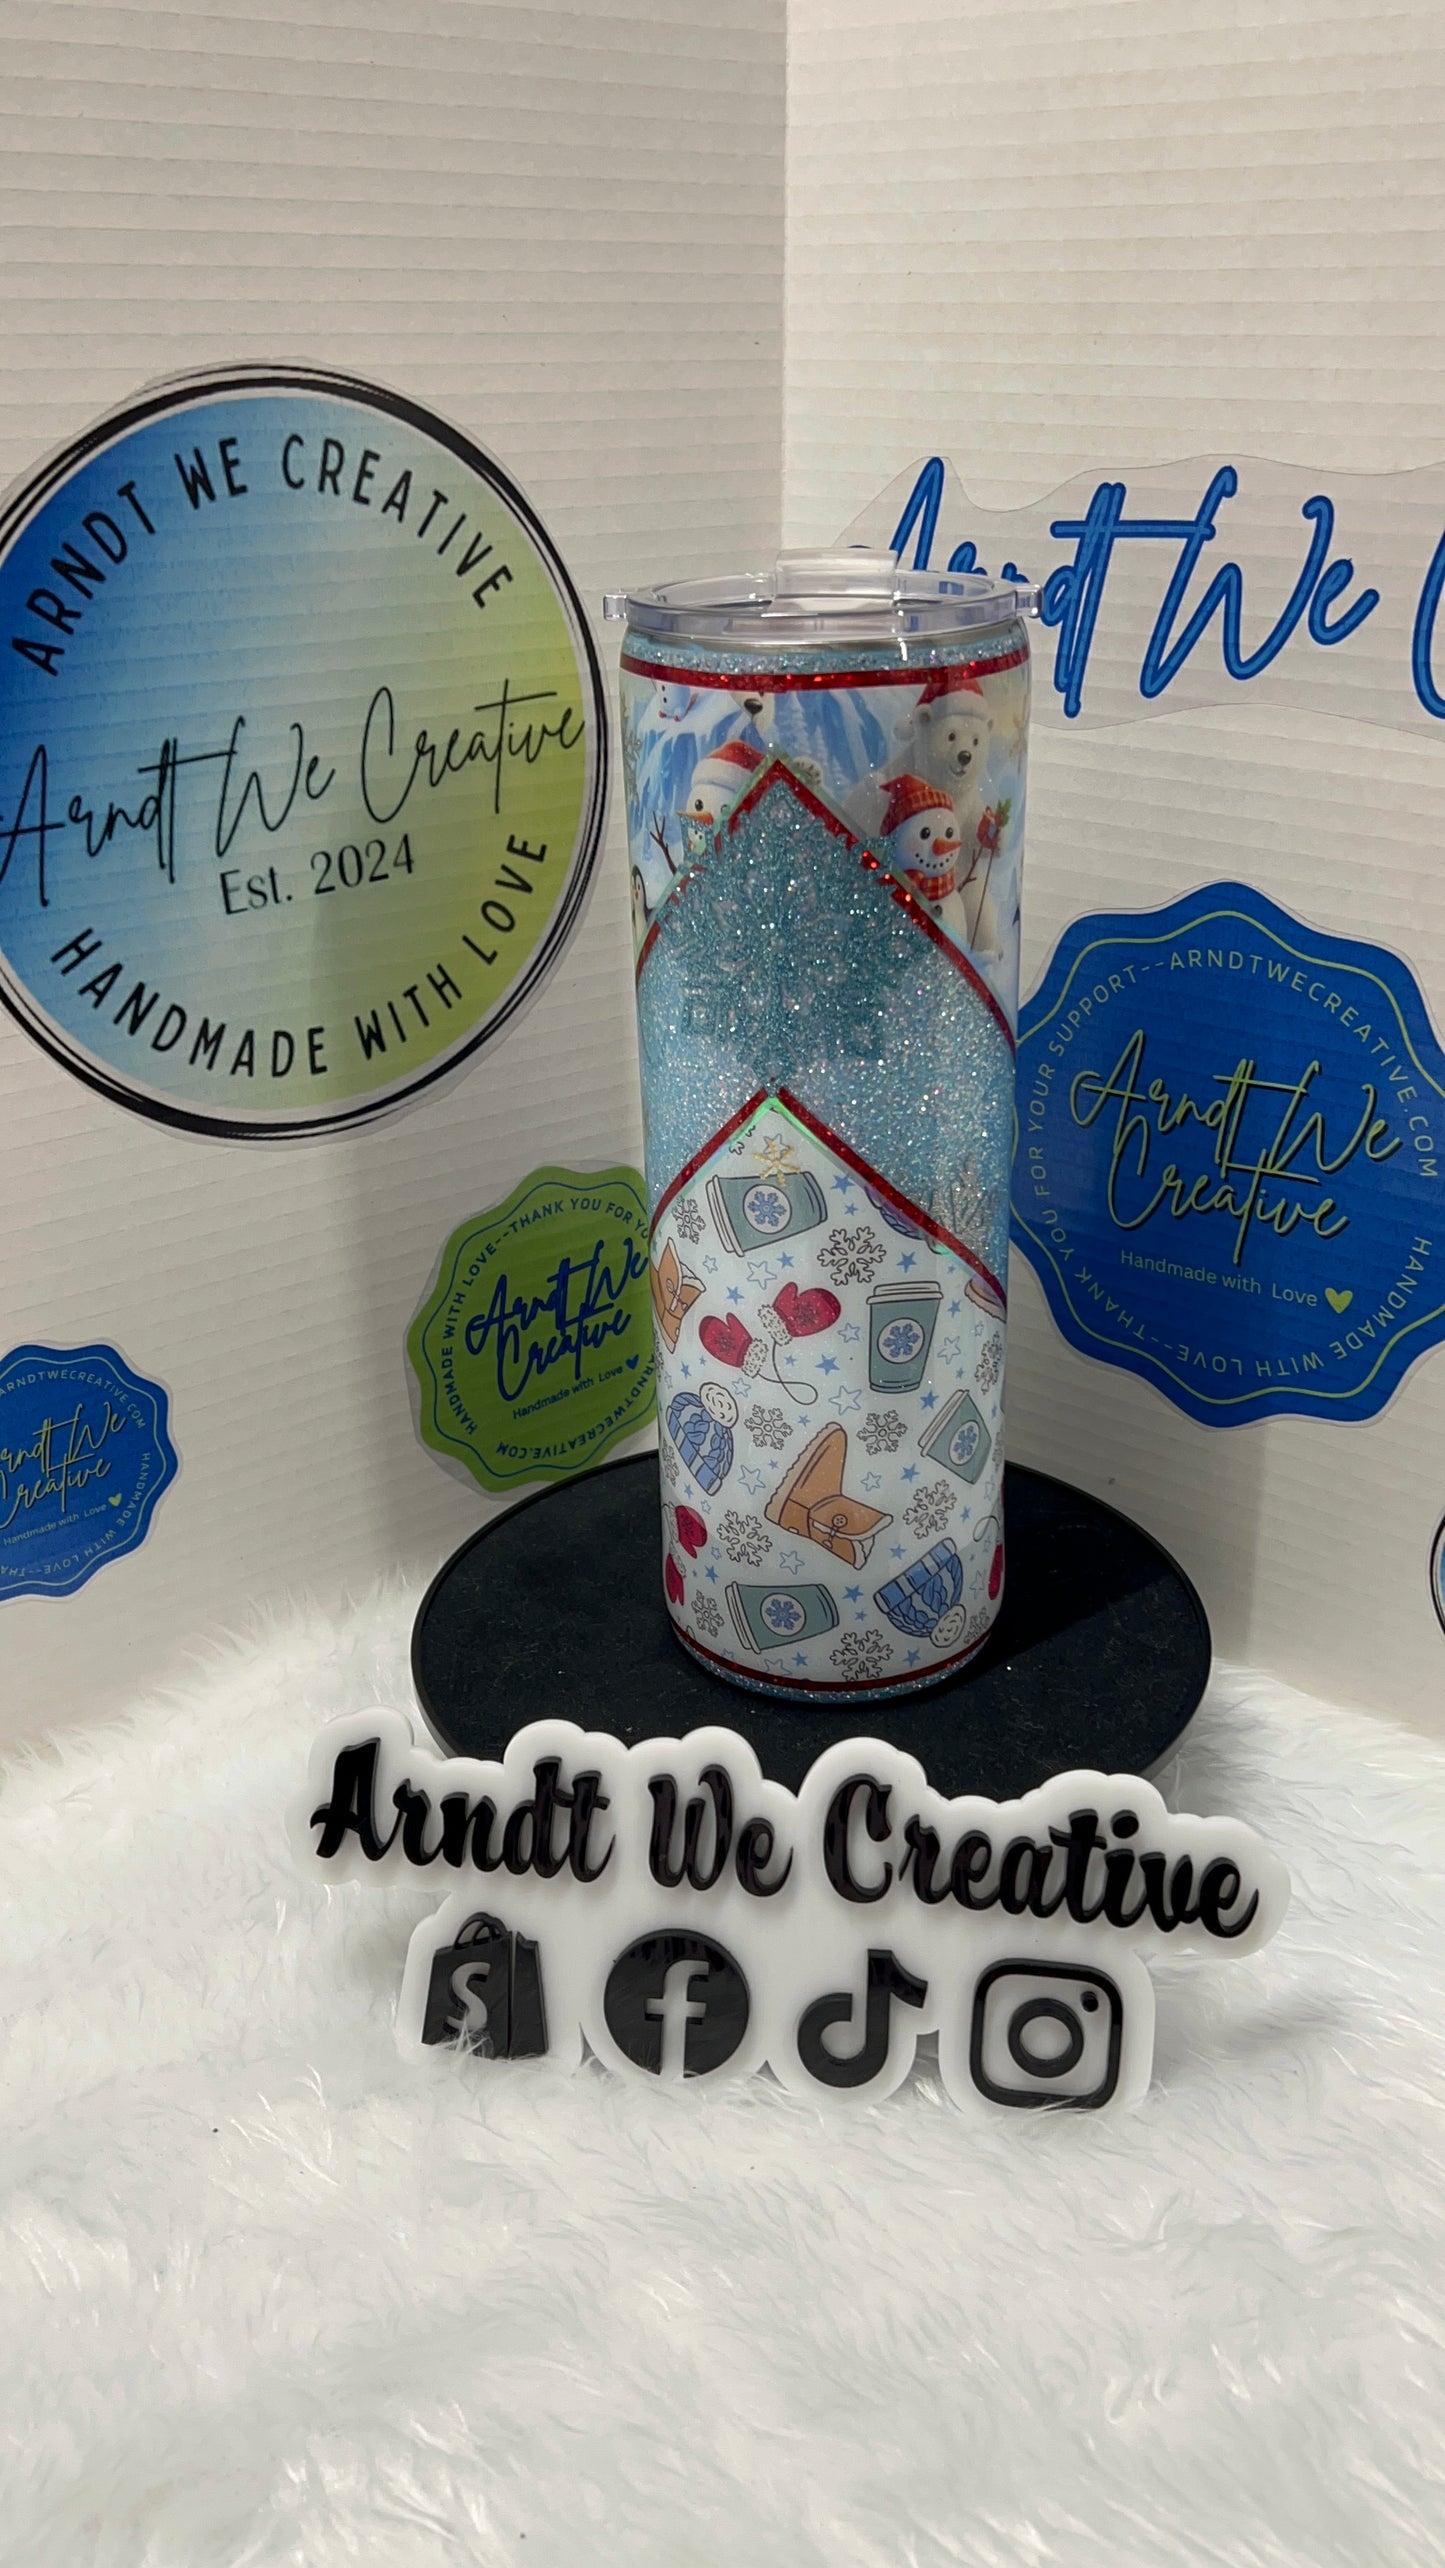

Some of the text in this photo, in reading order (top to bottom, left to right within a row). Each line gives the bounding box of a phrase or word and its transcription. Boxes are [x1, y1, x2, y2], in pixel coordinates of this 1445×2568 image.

[12, 432, 515, 677] ARNDT WE CREATIVE
[1140, 465, 1379, 698] We
[0, 678, 586, 908] Arndt We Creative
[219, 833, 416, 916] Est. 2024
[50, 833, 548, 1079] HANDMADE WITH LOVE
[1028, 1063, 1055, 1133] YOUR
[1070, 1029, 1401, 1179] Arndt We
[570, 1198, 602, 1211] YOU
[1028, 1146, 1050, 1197] FOR
[1107, 1114, 1349, 1265] Creative
[605, 1202, 633, 1224] FOR
[635, 1219, 648, 1239] YO
[1042, 1209, 1075, 1262] YOU
[443, 1292, 466, 1339] WITH
[465, 1237, 648, 1357] Arndt We
[1121, 1250, 1318, 1307] Handmade with Love
[1329, 1236, 1433, 1360] HANDMADE
[441, 1346, 478, 1435] HANDMADE
[497, 1303, 631, 1402] Creative
[1256, 1352, 1325, 1377] WITH
[0, 1369, 146, 1429] ARNDTWECREATIVECOM
[513, 1366, 624, 1420] Handmade with Love
[0, 1401, 127, 1479] rndt We
[3, 1504, 107, 1546] Handmade with Love
[116, 1452, 150, 1528] HANDMADE
[84, 1529, 117, 1557] WITH
[311, 1734, 1260, 1939] Arndt We Creative
